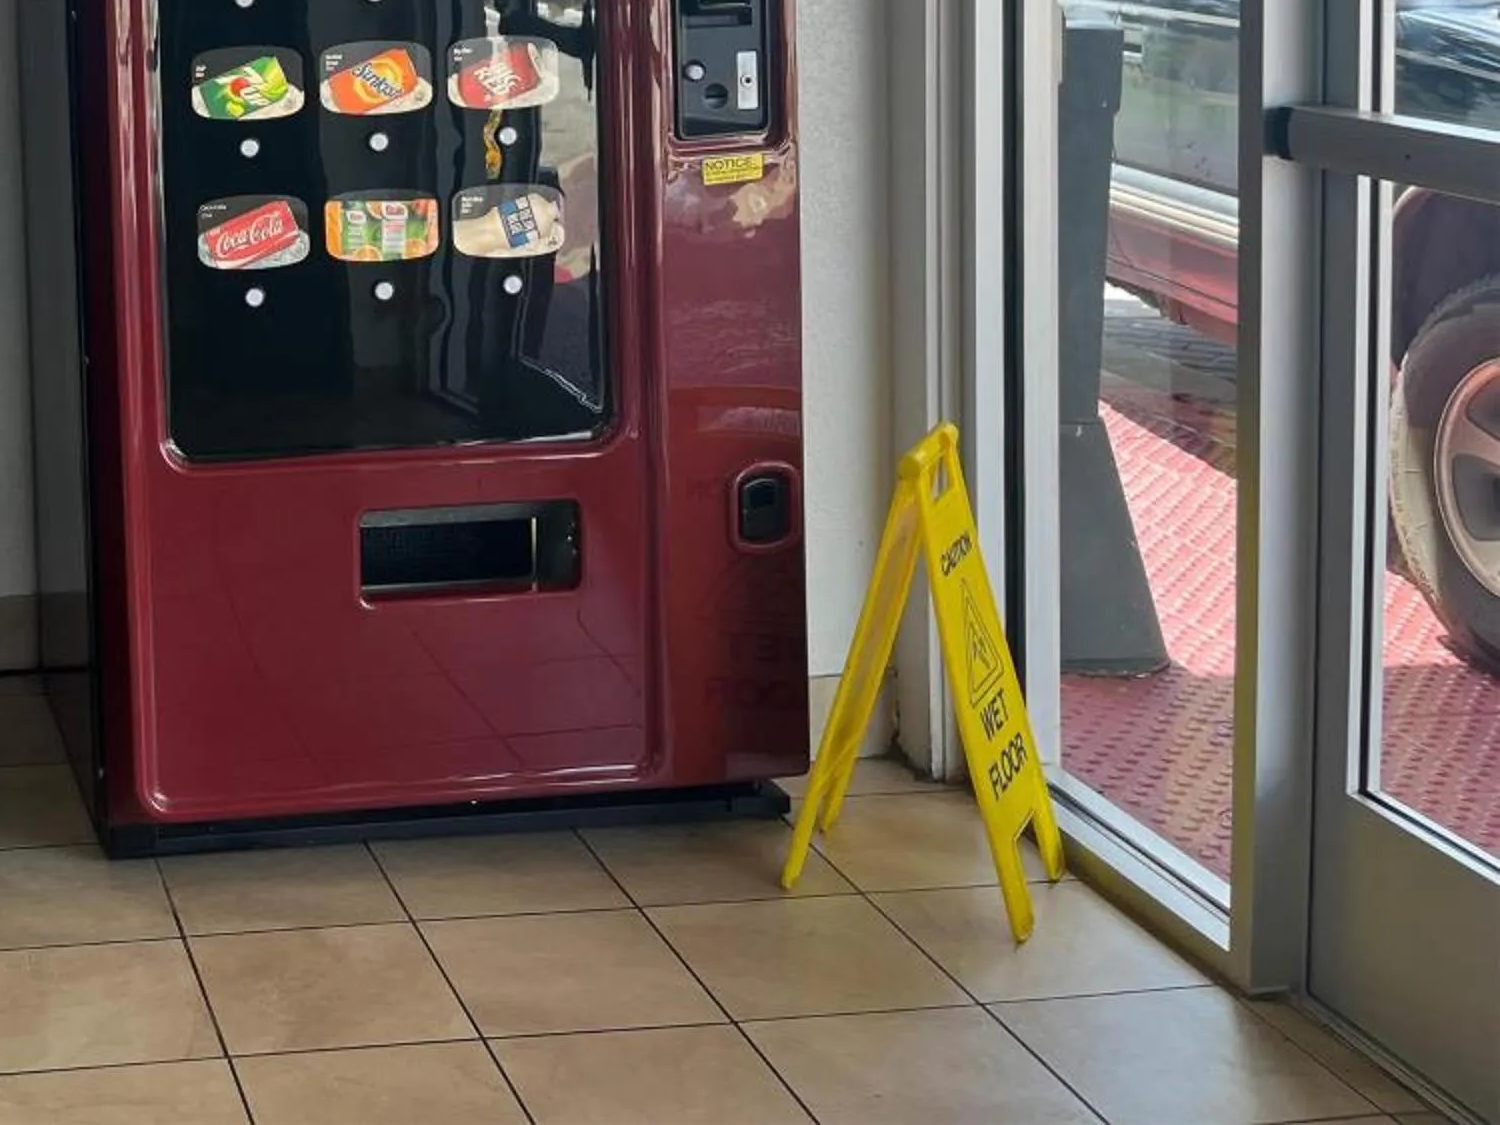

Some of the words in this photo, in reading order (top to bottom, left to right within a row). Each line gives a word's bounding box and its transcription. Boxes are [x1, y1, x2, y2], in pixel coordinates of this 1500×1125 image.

[352, 62, 403, 101] Sunkist
[941, 531, 972, 577] CAUTION
[980, 688, 1009, 741] WET
[988, 731, 1028, 802] FLOOR
